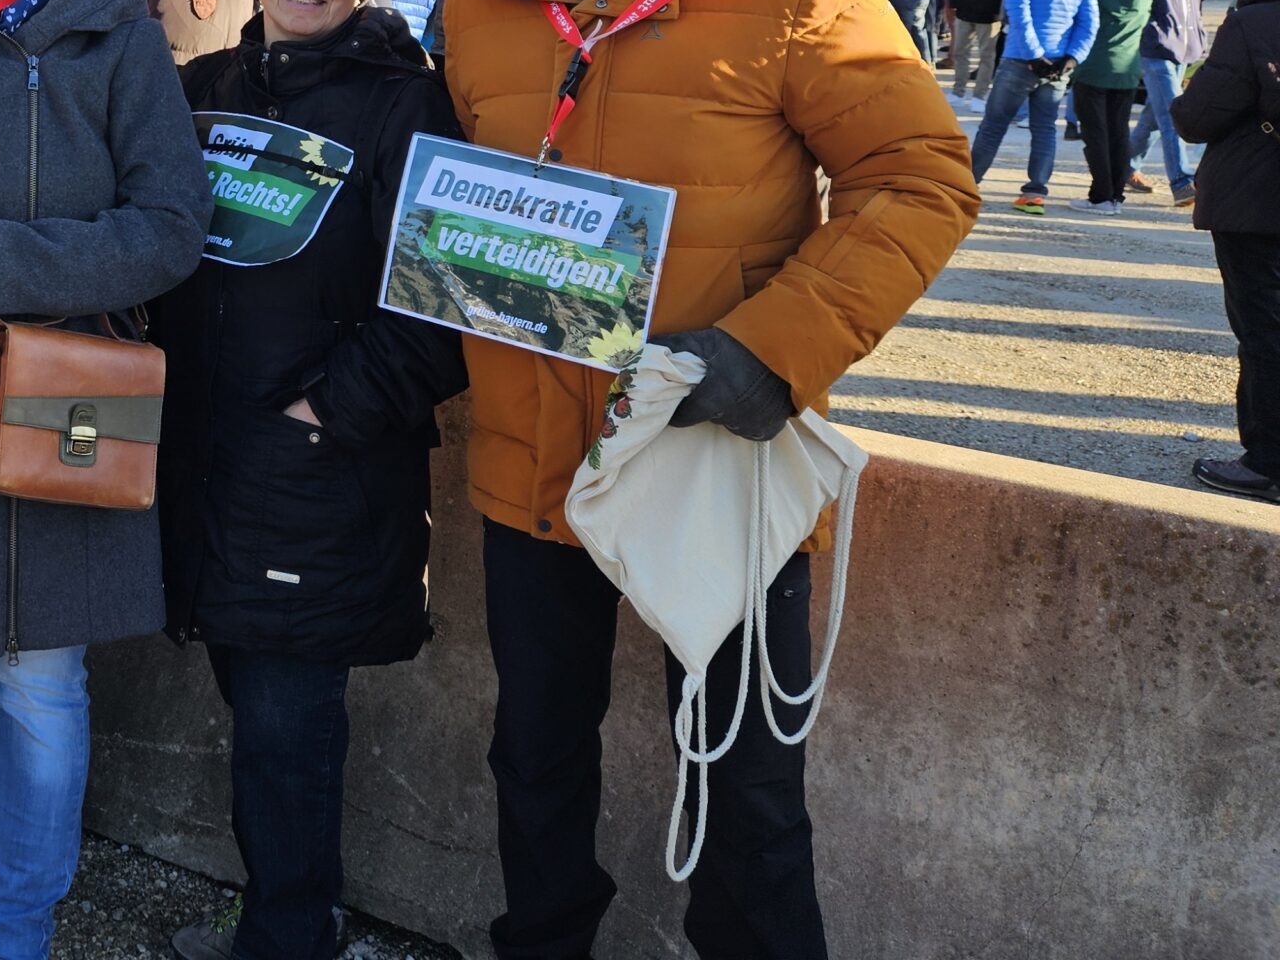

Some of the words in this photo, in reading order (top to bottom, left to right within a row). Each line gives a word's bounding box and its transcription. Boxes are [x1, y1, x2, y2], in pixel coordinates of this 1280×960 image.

[213, 171, 303, 217] Rechts!
[431, 168, 603, 234] Demokratie
[437, 226, 626, 295] verteidigen!
[466, 304, 548, 334] grüne-bayern.de
